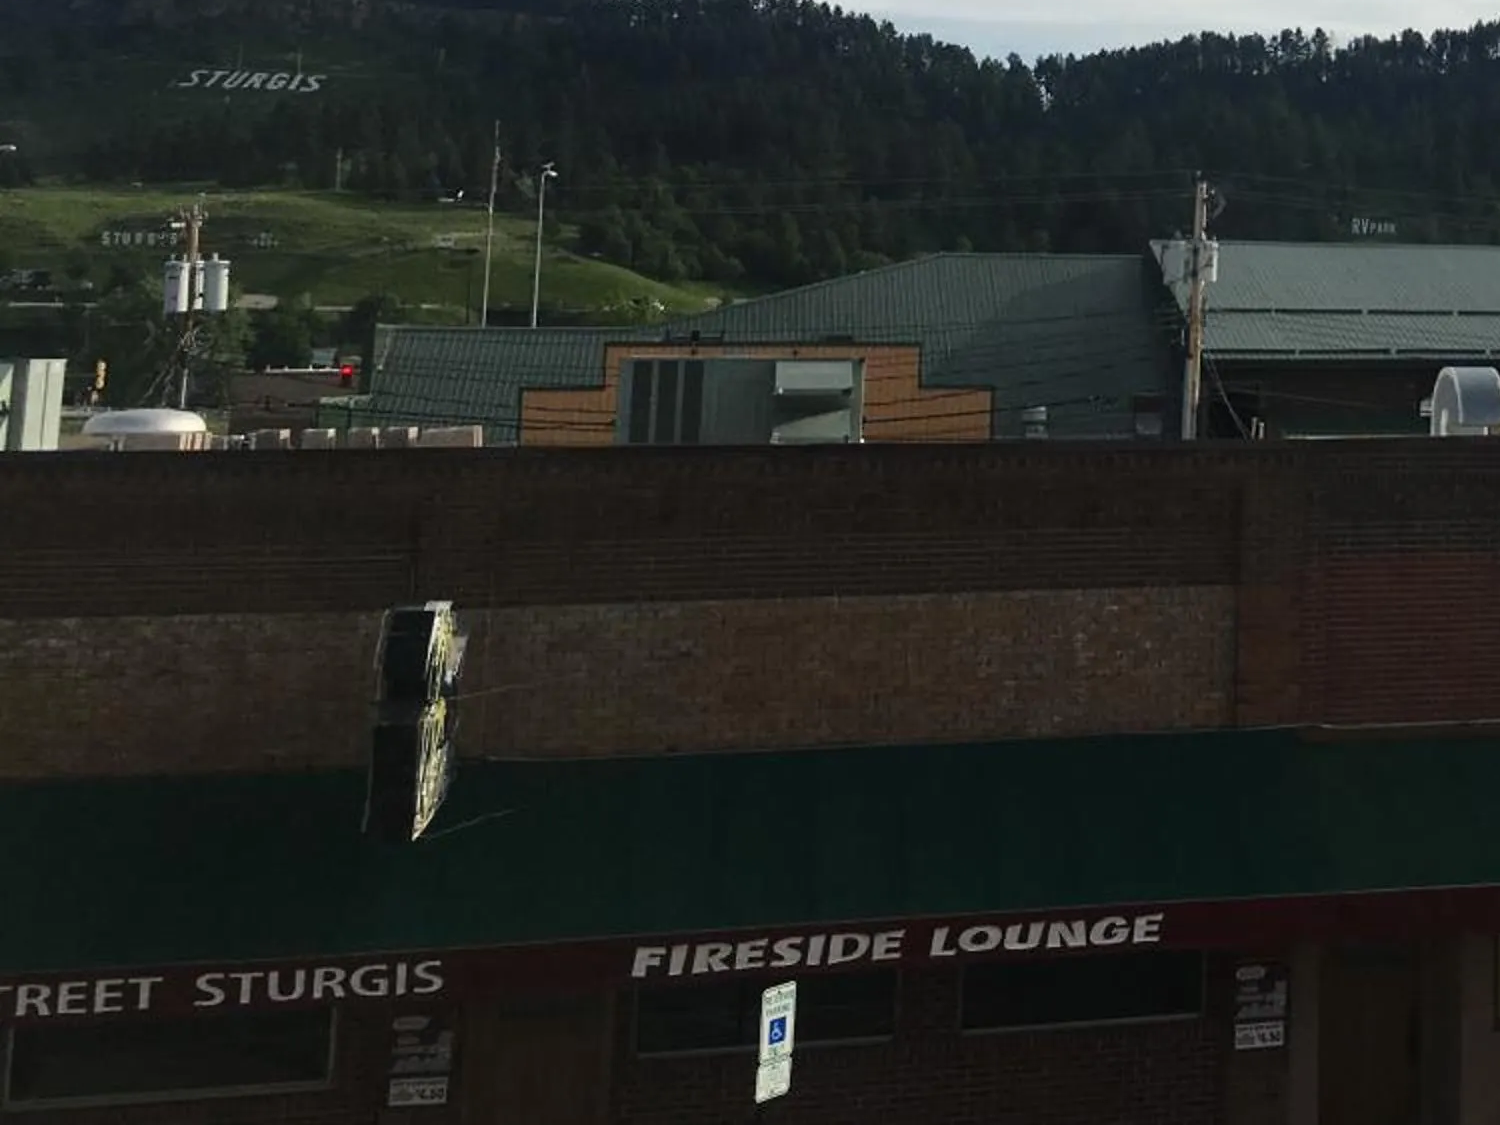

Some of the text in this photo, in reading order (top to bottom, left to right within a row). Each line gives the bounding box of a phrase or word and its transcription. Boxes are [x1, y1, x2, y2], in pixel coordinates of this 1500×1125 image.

[177, 69, 328, 92] STURGIS
[631, 911, 1165, 979] FIRESIDE LOUNGE
[193, 959, 445, 1008] STURGIS
